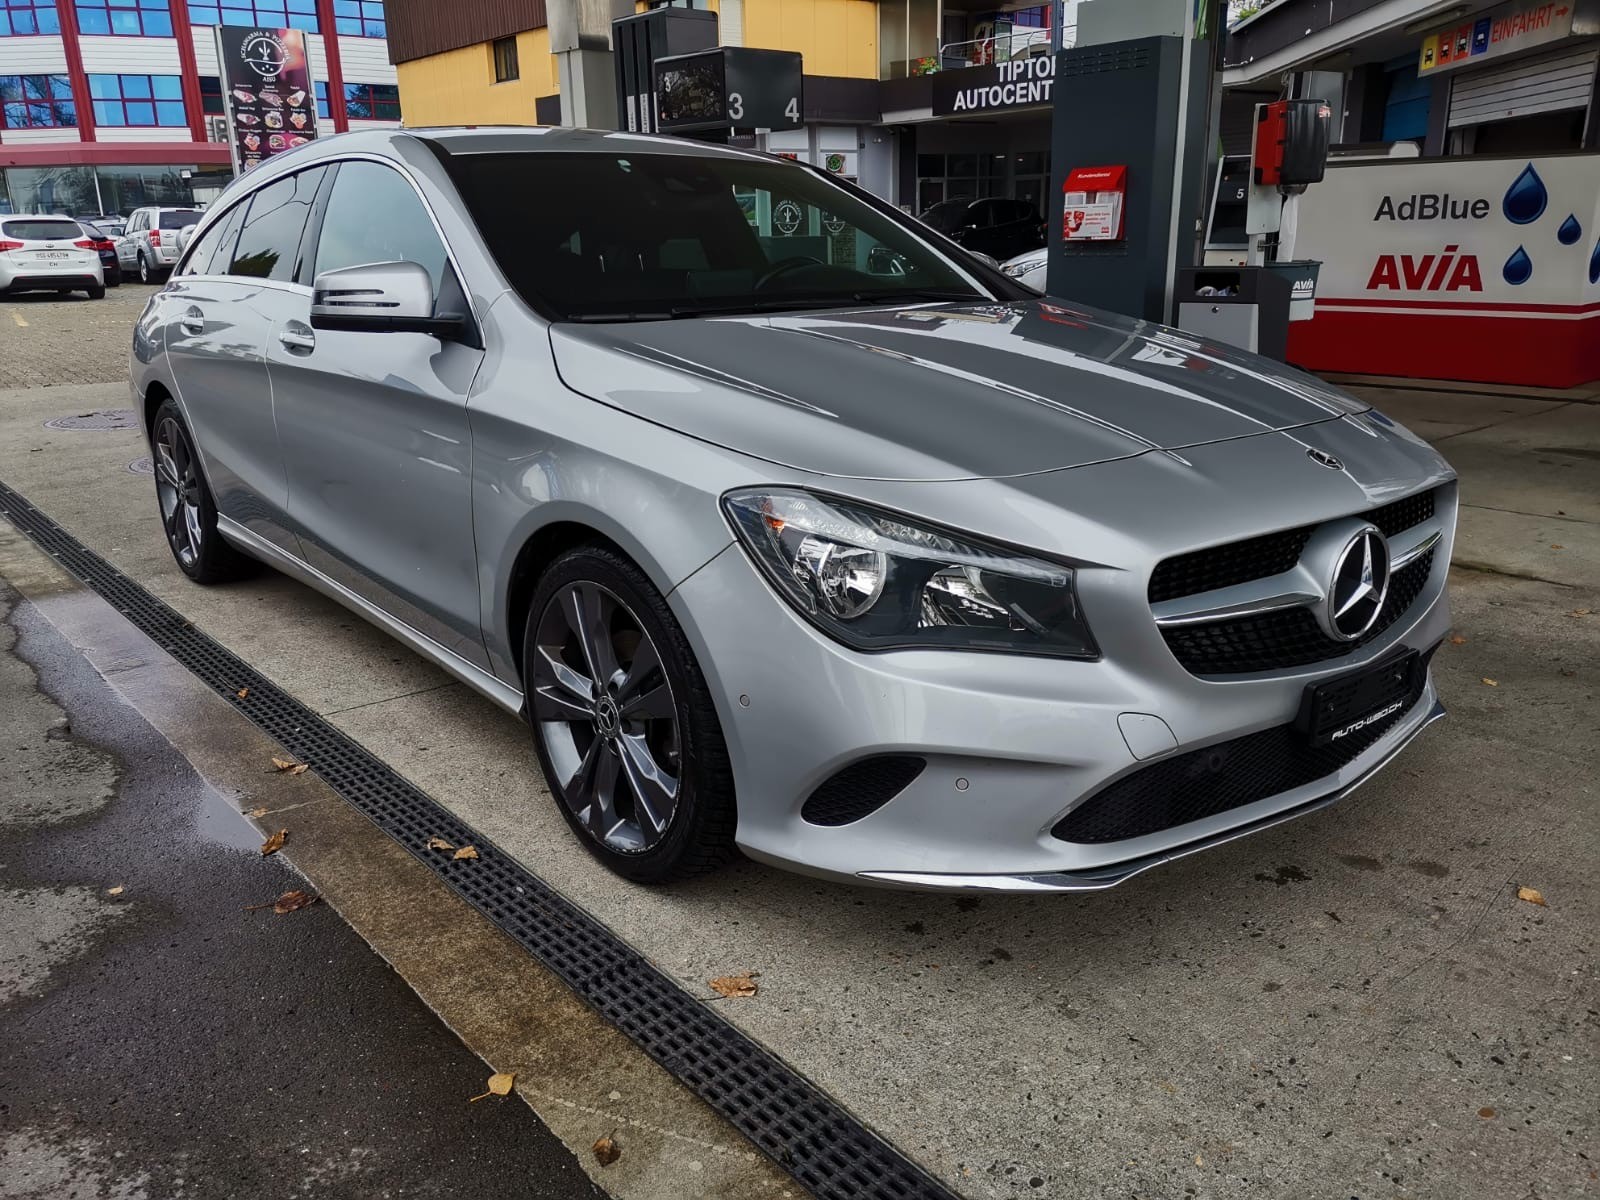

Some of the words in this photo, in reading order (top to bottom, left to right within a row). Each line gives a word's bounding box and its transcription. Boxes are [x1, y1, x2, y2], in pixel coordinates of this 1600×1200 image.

[1492, 3, 1555, 42] EINFAHRT
[664, 77, 671, 92] 3
[728, 92, 744, 120] 3
[784, 97, 800, 123] 4
[1236, 188, 1245, 199] 5
[1373, 193, 1490, 222] AdBlue
[1366, 244, 1483, 292] AVIA
[1292, 277, 1314, 290] AVIA
